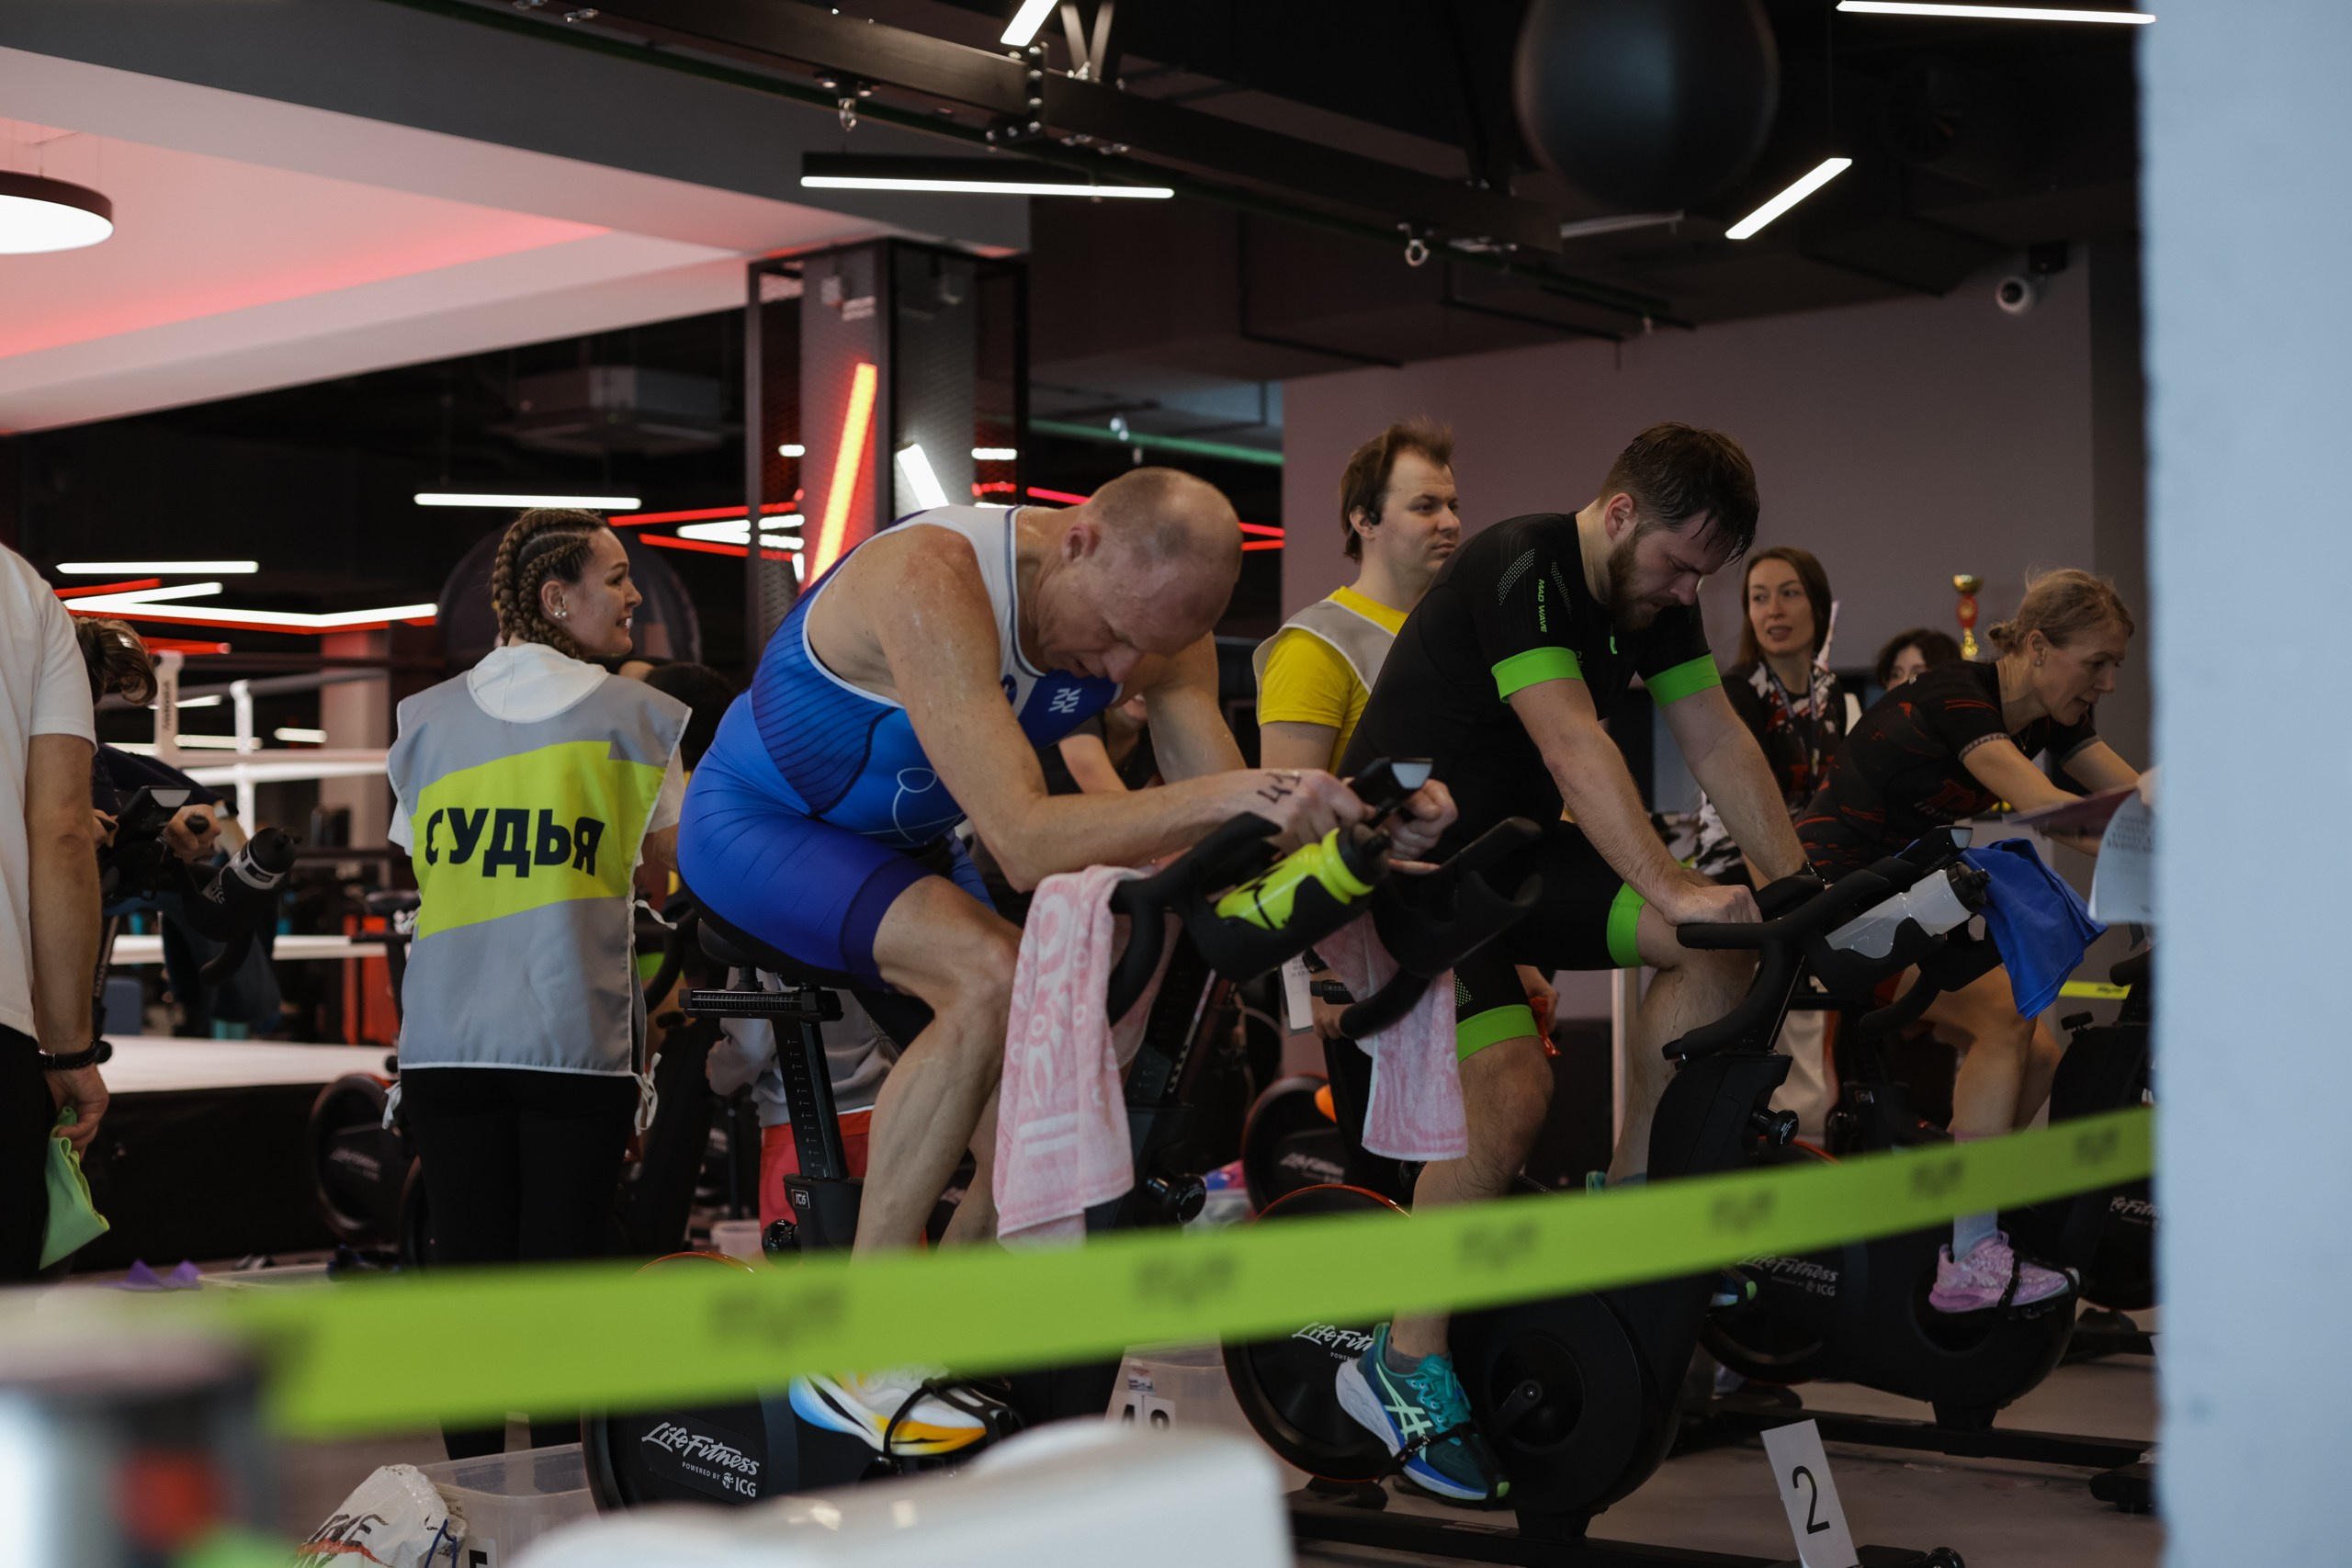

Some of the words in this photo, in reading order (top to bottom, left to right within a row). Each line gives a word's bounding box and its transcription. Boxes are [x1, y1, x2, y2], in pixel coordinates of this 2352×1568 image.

[1537, 579, 1545, 603] MAD
[1537, 604, 1548, 633] WAVE
[424, 807, 605, 878] СУДЬЯ
[1815, 1282, 1837, 1298] ICG
[681, 1461, 711, 1478] POWERED
[712, 1472, 721, 1482] BY
[735, 1476, 758, 1498] ICG
[1792, 1465, 1831, 1535] 2
